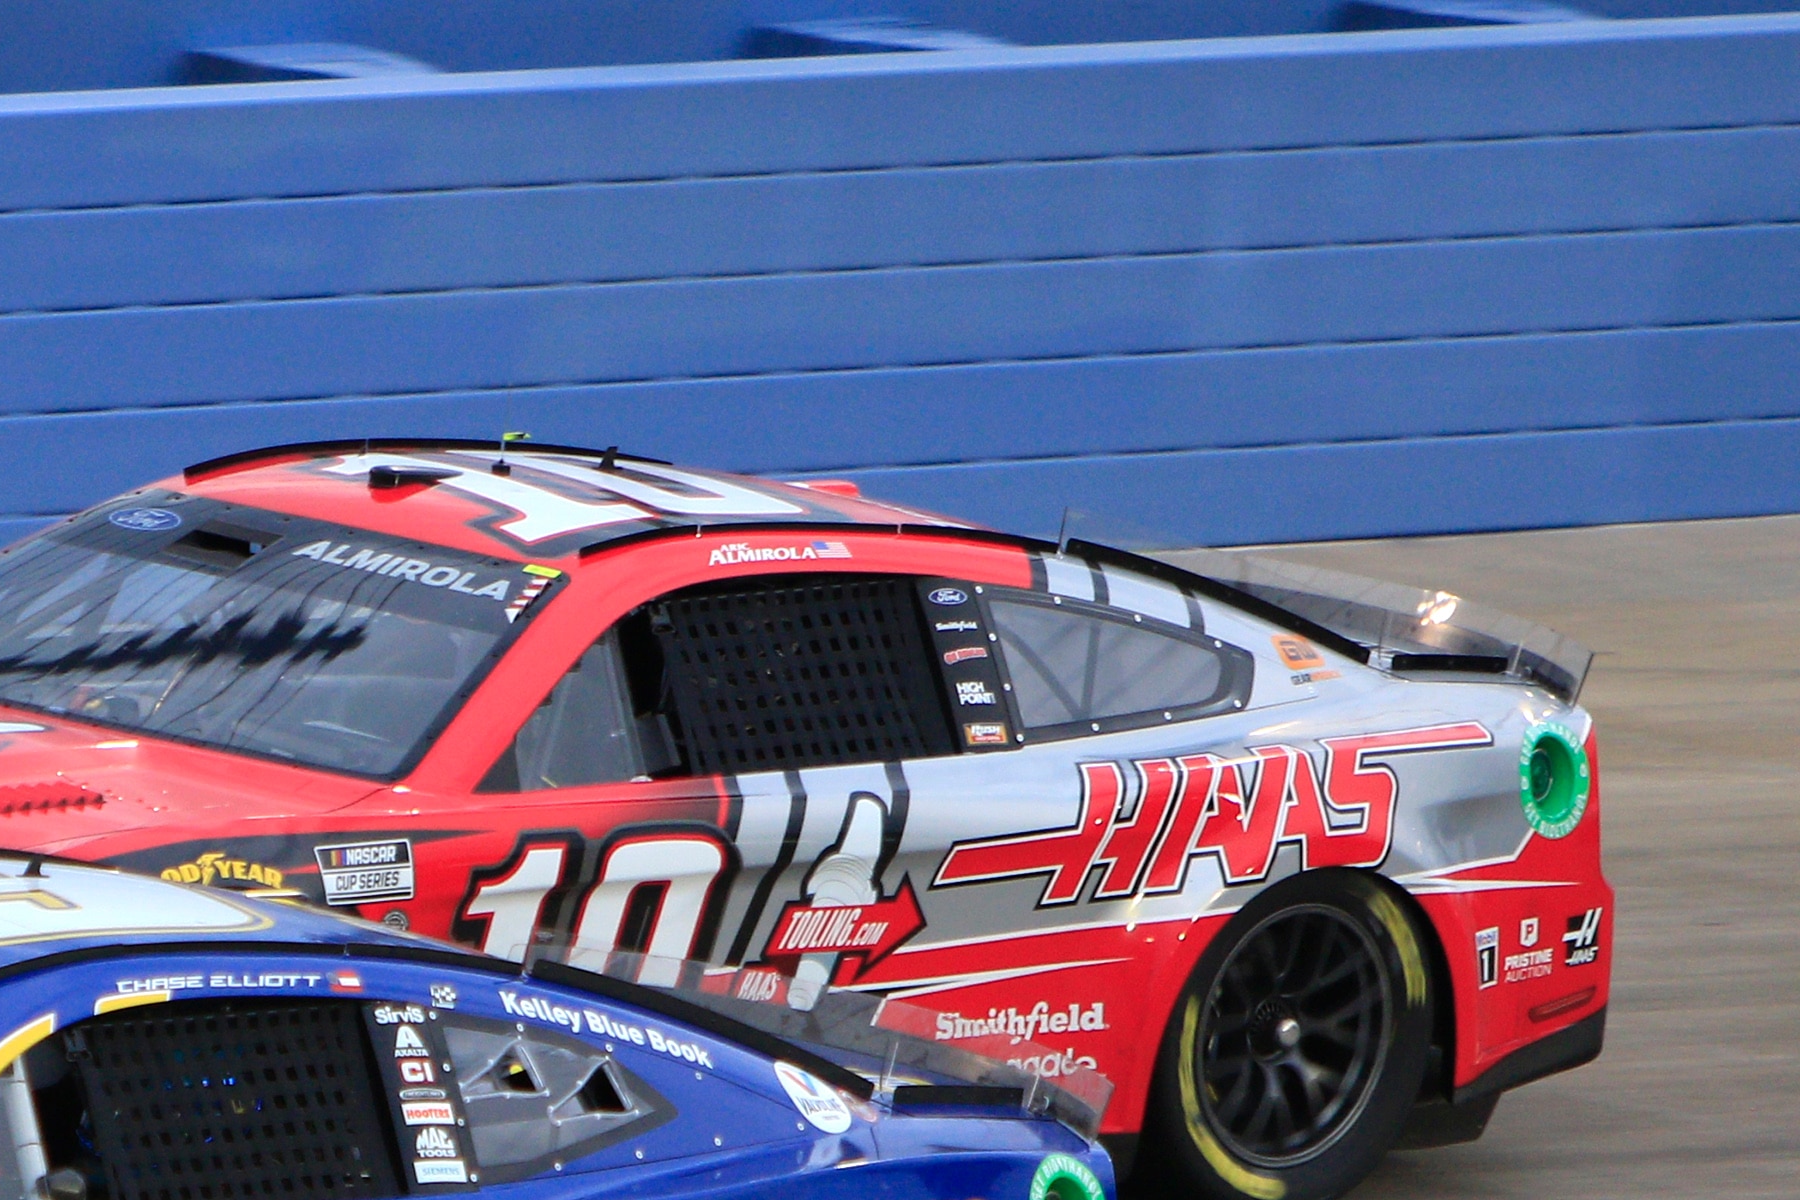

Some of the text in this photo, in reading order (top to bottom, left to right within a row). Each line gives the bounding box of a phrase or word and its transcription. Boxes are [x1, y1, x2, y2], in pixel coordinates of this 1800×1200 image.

[708, 547, 817, 566] ALMIROLA
[719, 542, 750, 552] ARIC
[291, 540, 511, 601] ALMIROLA
[929, 720, 1494, 911] HAAS
[345, 845, 398, 866] NASCAR
[335, 871, 400, 892] CUP SERIES
[462, 836, 726, 989] 10
[1503, 948, 1554, 970] PRISTINE
[115, 974, 321, 993] CHASE ELLIOTT
[1503, 963, 1553, 983] AUCTION
[498, 990, 713, 1070] Kelley Blue Book
[935, 1001, 1105, 1045] Smithfield
[416, 1149, 457, 1158] TOOLS
